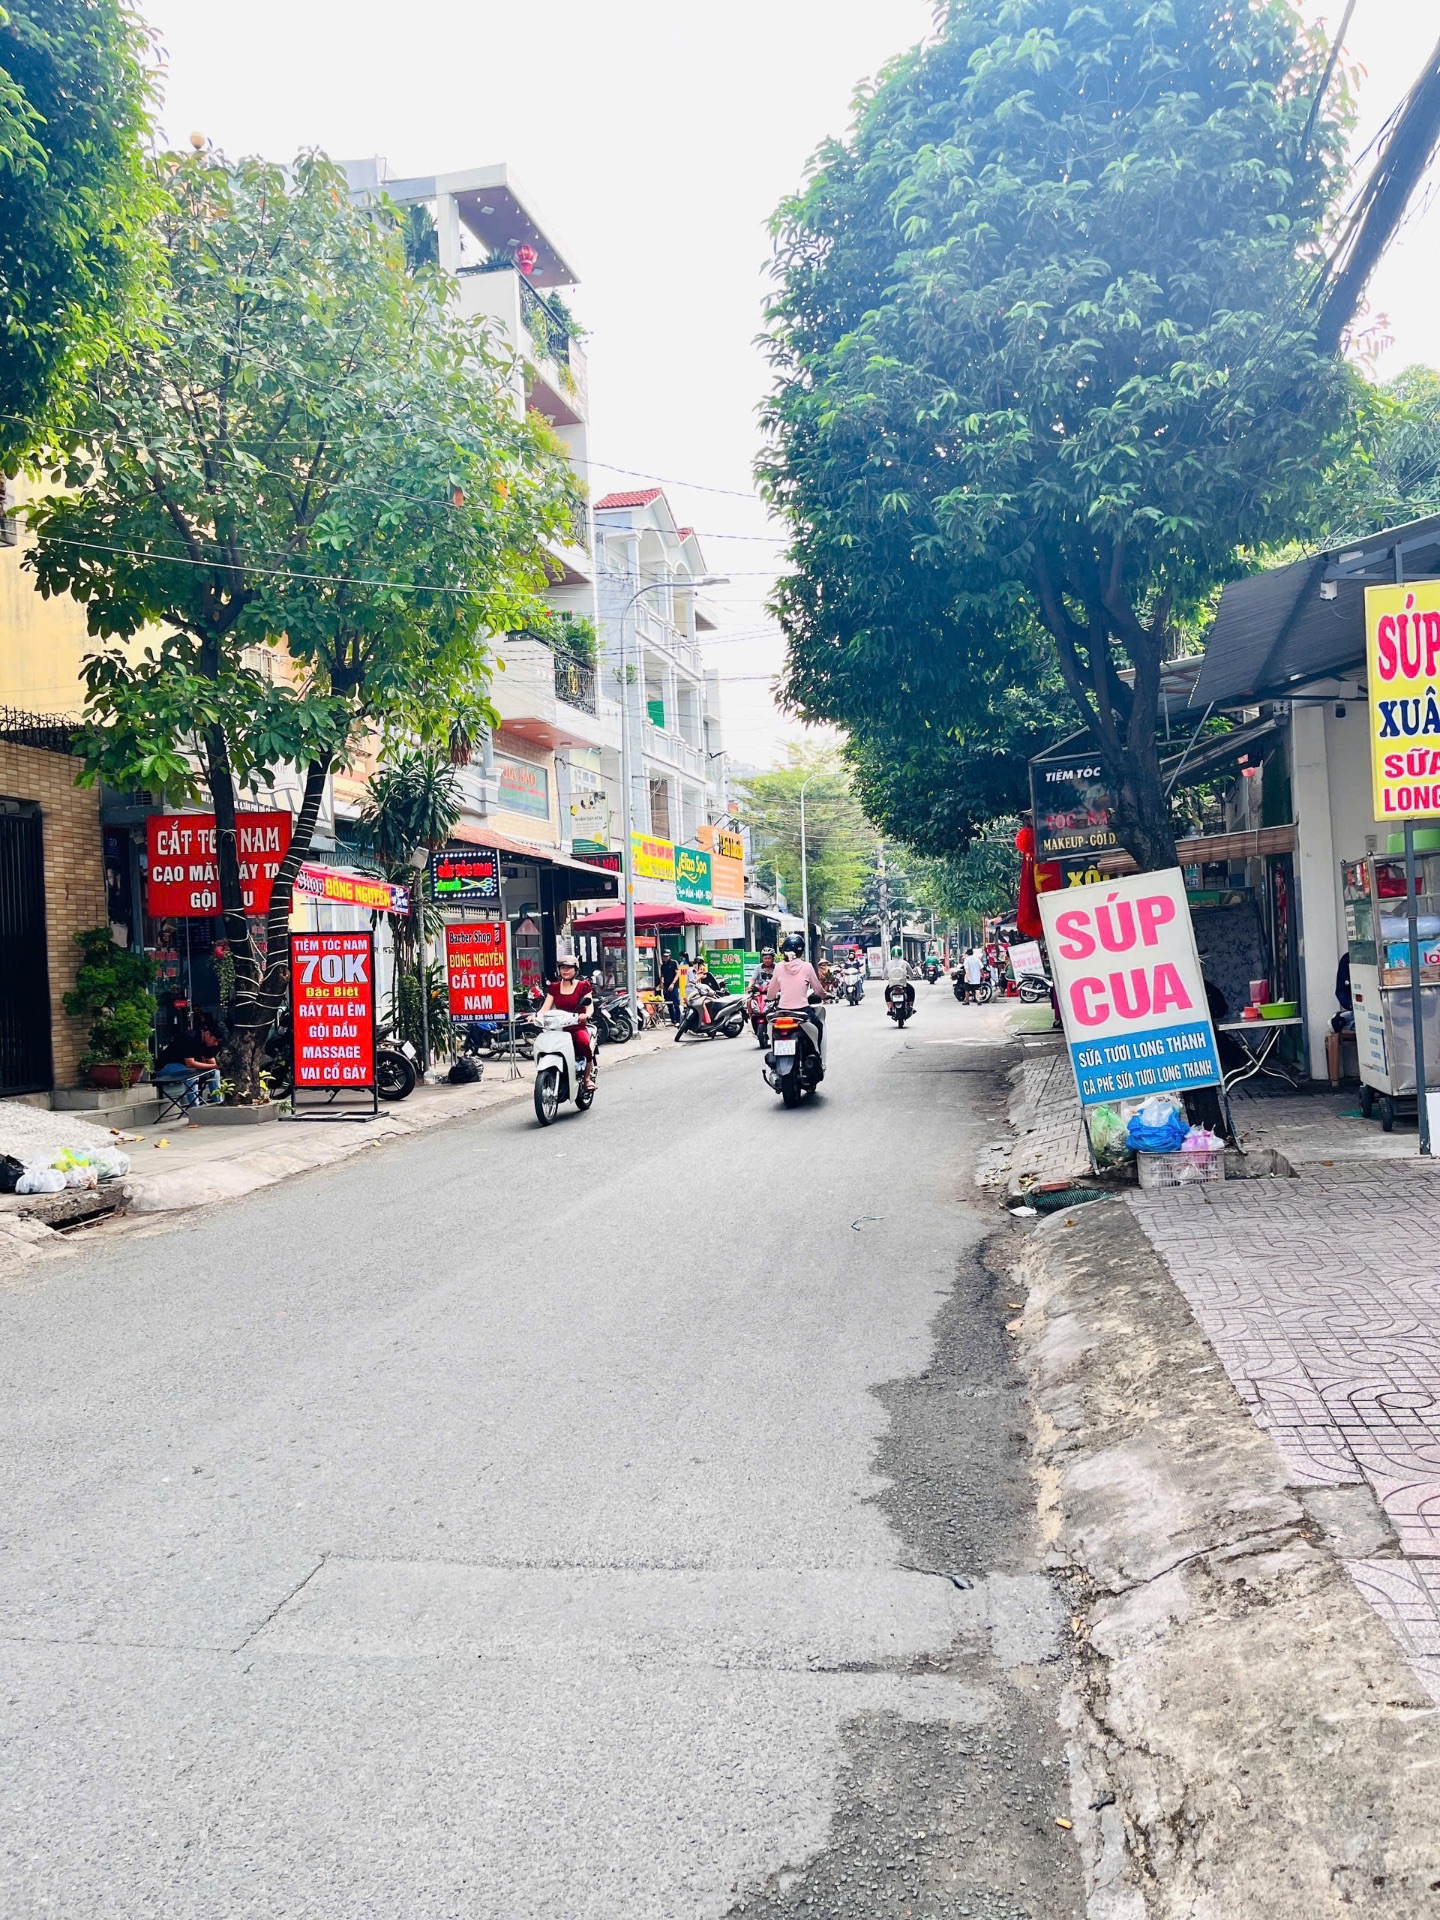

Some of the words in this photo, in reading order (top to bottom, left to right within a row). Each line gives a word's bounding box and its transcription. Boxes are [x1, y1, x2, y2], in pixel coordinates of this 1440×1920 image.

[1378, 593, 1440, 681] SÚP
[1045, 768, 1074, 784] TIỆM
[1076, 766, 1102, 779] TÓC
[1045, 810, 1076, 831] TÓC
[1085, 809, 1109, 827] NA
[157, 820, 192, 856] CẮT
[198, 826, 217, 855] TÓ
[240, 827, 280, 853] NAM
[1043, 835, 1084, 852] MAKEUP
[1089, 831, 1107, 849] GỘI
[152, 865, 184, 886] CẠO
[238, 861, 259, 880] ÁY
[263, 862, 280, 879] TA
[455, 859, 473, 877] TÓC
[696, 855, 707, 878] Spa
[190, 889, 217, 912] GỘI
[1055, 892, 1176, 960] SÚP
[294, 939, 319, 953] TIỆM
[321, 938, 341, 950] TÓC
[343, 939, 368, 950] NAM
[449, 931, 473, 944] Barber
[474, 930, 491, 945] Shop
[449, 951, 471, 968] ĐÔNG
[473, 947, 505, 967] NGUYỄN
[295, 953, 369, 984] 70K
[452, 969, 477, 990] CẮT
[480, 970, 505, 988] TÓC
[464, 995, 493, 1011] NAM
[1069, 962, 1193, 1026] CUA
[299, 1002, 324, 1017] RÁY
[326, 1004, 344, 1017] TAI
[347, 1001, 366, 1017] ÊM
[309, 1023, 330, 1041] GỘI
[302, 1046, 361, 1059] MASSAGE
[1078, 1049, 1103, 1068] SỮA
[1104, 1044, 1131, 1063] TƯƠI
[1133, 1038, 1165, 1058] LONG
[1166, 1032, 1207, 1055] THÀNH
[301, 1067, 320, 1080] VAI
[323, 1062, 340, 1080] CỔ
[343, 1064, 367, 1080] GÁY
[1082, 1079, 1096, 1096] CÀ
[1097, 1072, 1115, 1093] PHÊ
[1116, 1072, 1134, 1091] SỮA
[1135, 1067, 1157, 1086] TƯƠI
[1158, 1065, 1182, 1084] LONG
[1181, 1058, 1214, 1080] THÀNH
